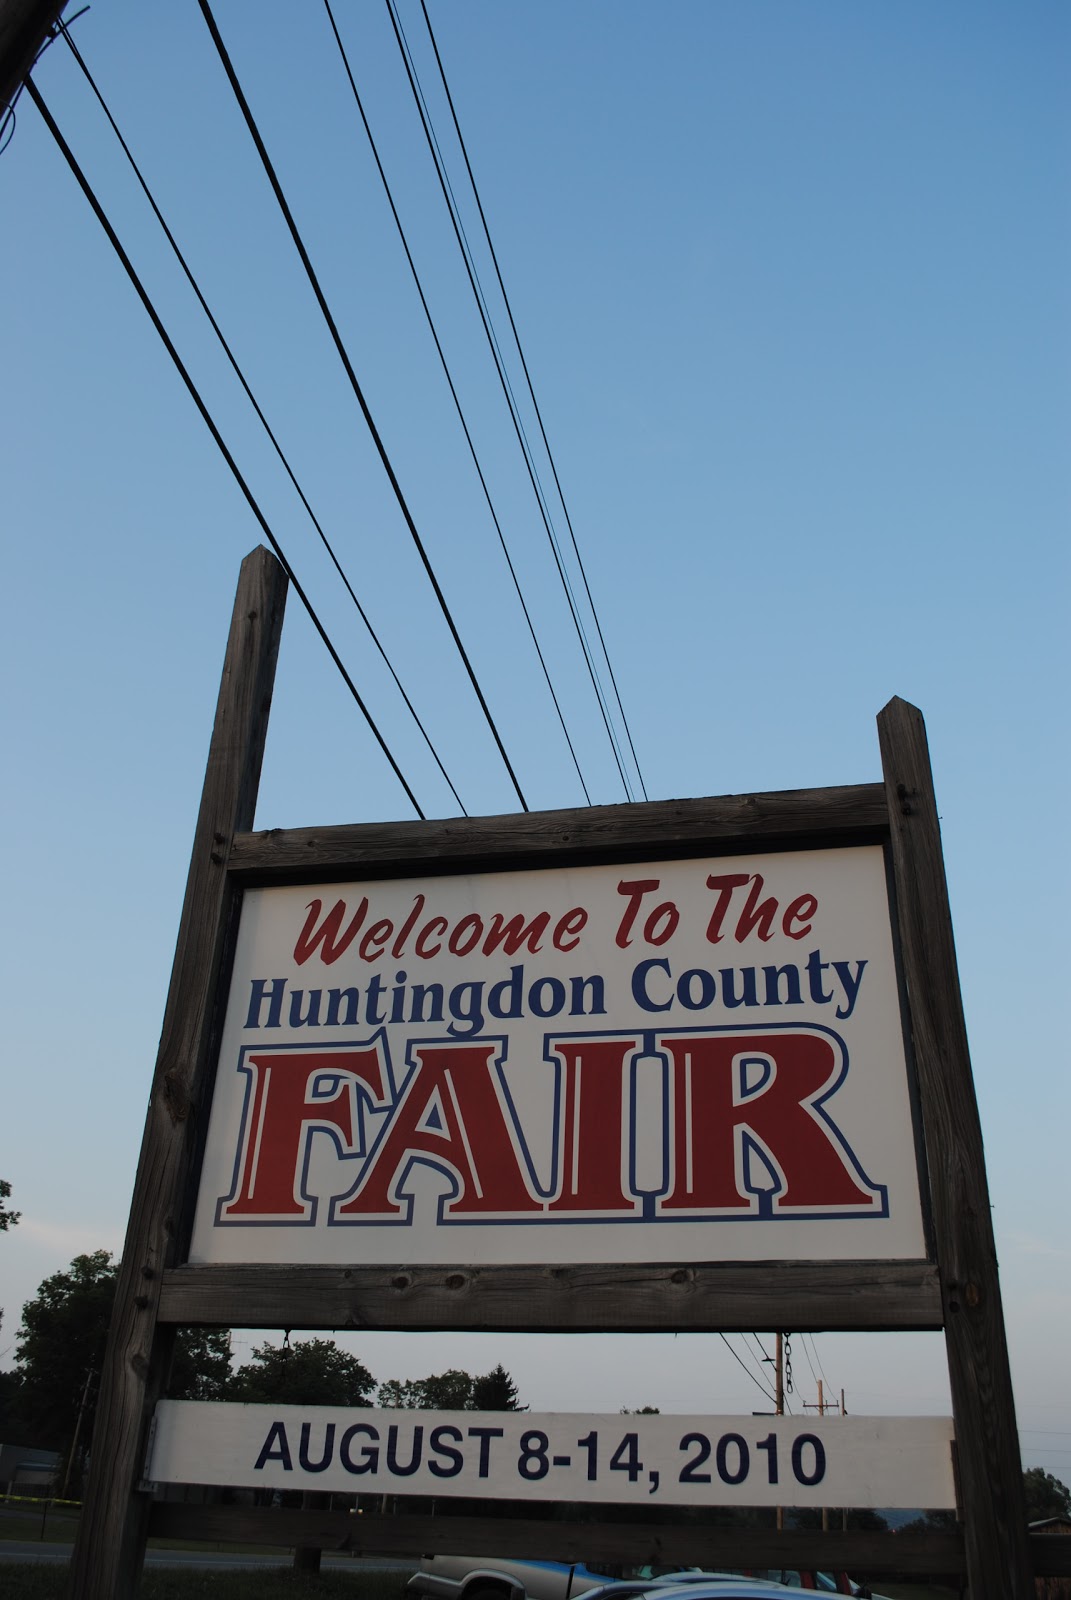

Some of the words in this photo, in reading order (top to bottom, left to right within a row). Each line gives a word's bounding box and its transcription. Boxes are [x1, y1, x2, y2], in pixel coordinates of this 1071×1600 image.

[292, 893, 589, 966] Welcome
[615, 878, 680, 948] To
[706, 872, 818, 946] The
[243, 963, 606, 1036] Huntingdon
[631, 949, 868, 1020] County
[213, 1022, 890, 1227] FAIR
[254, 1420, 504, 1479] AUGUST
[518, 1429, 660, 1495] 8-14,
[678, 1432, 826, 1486] 2010
